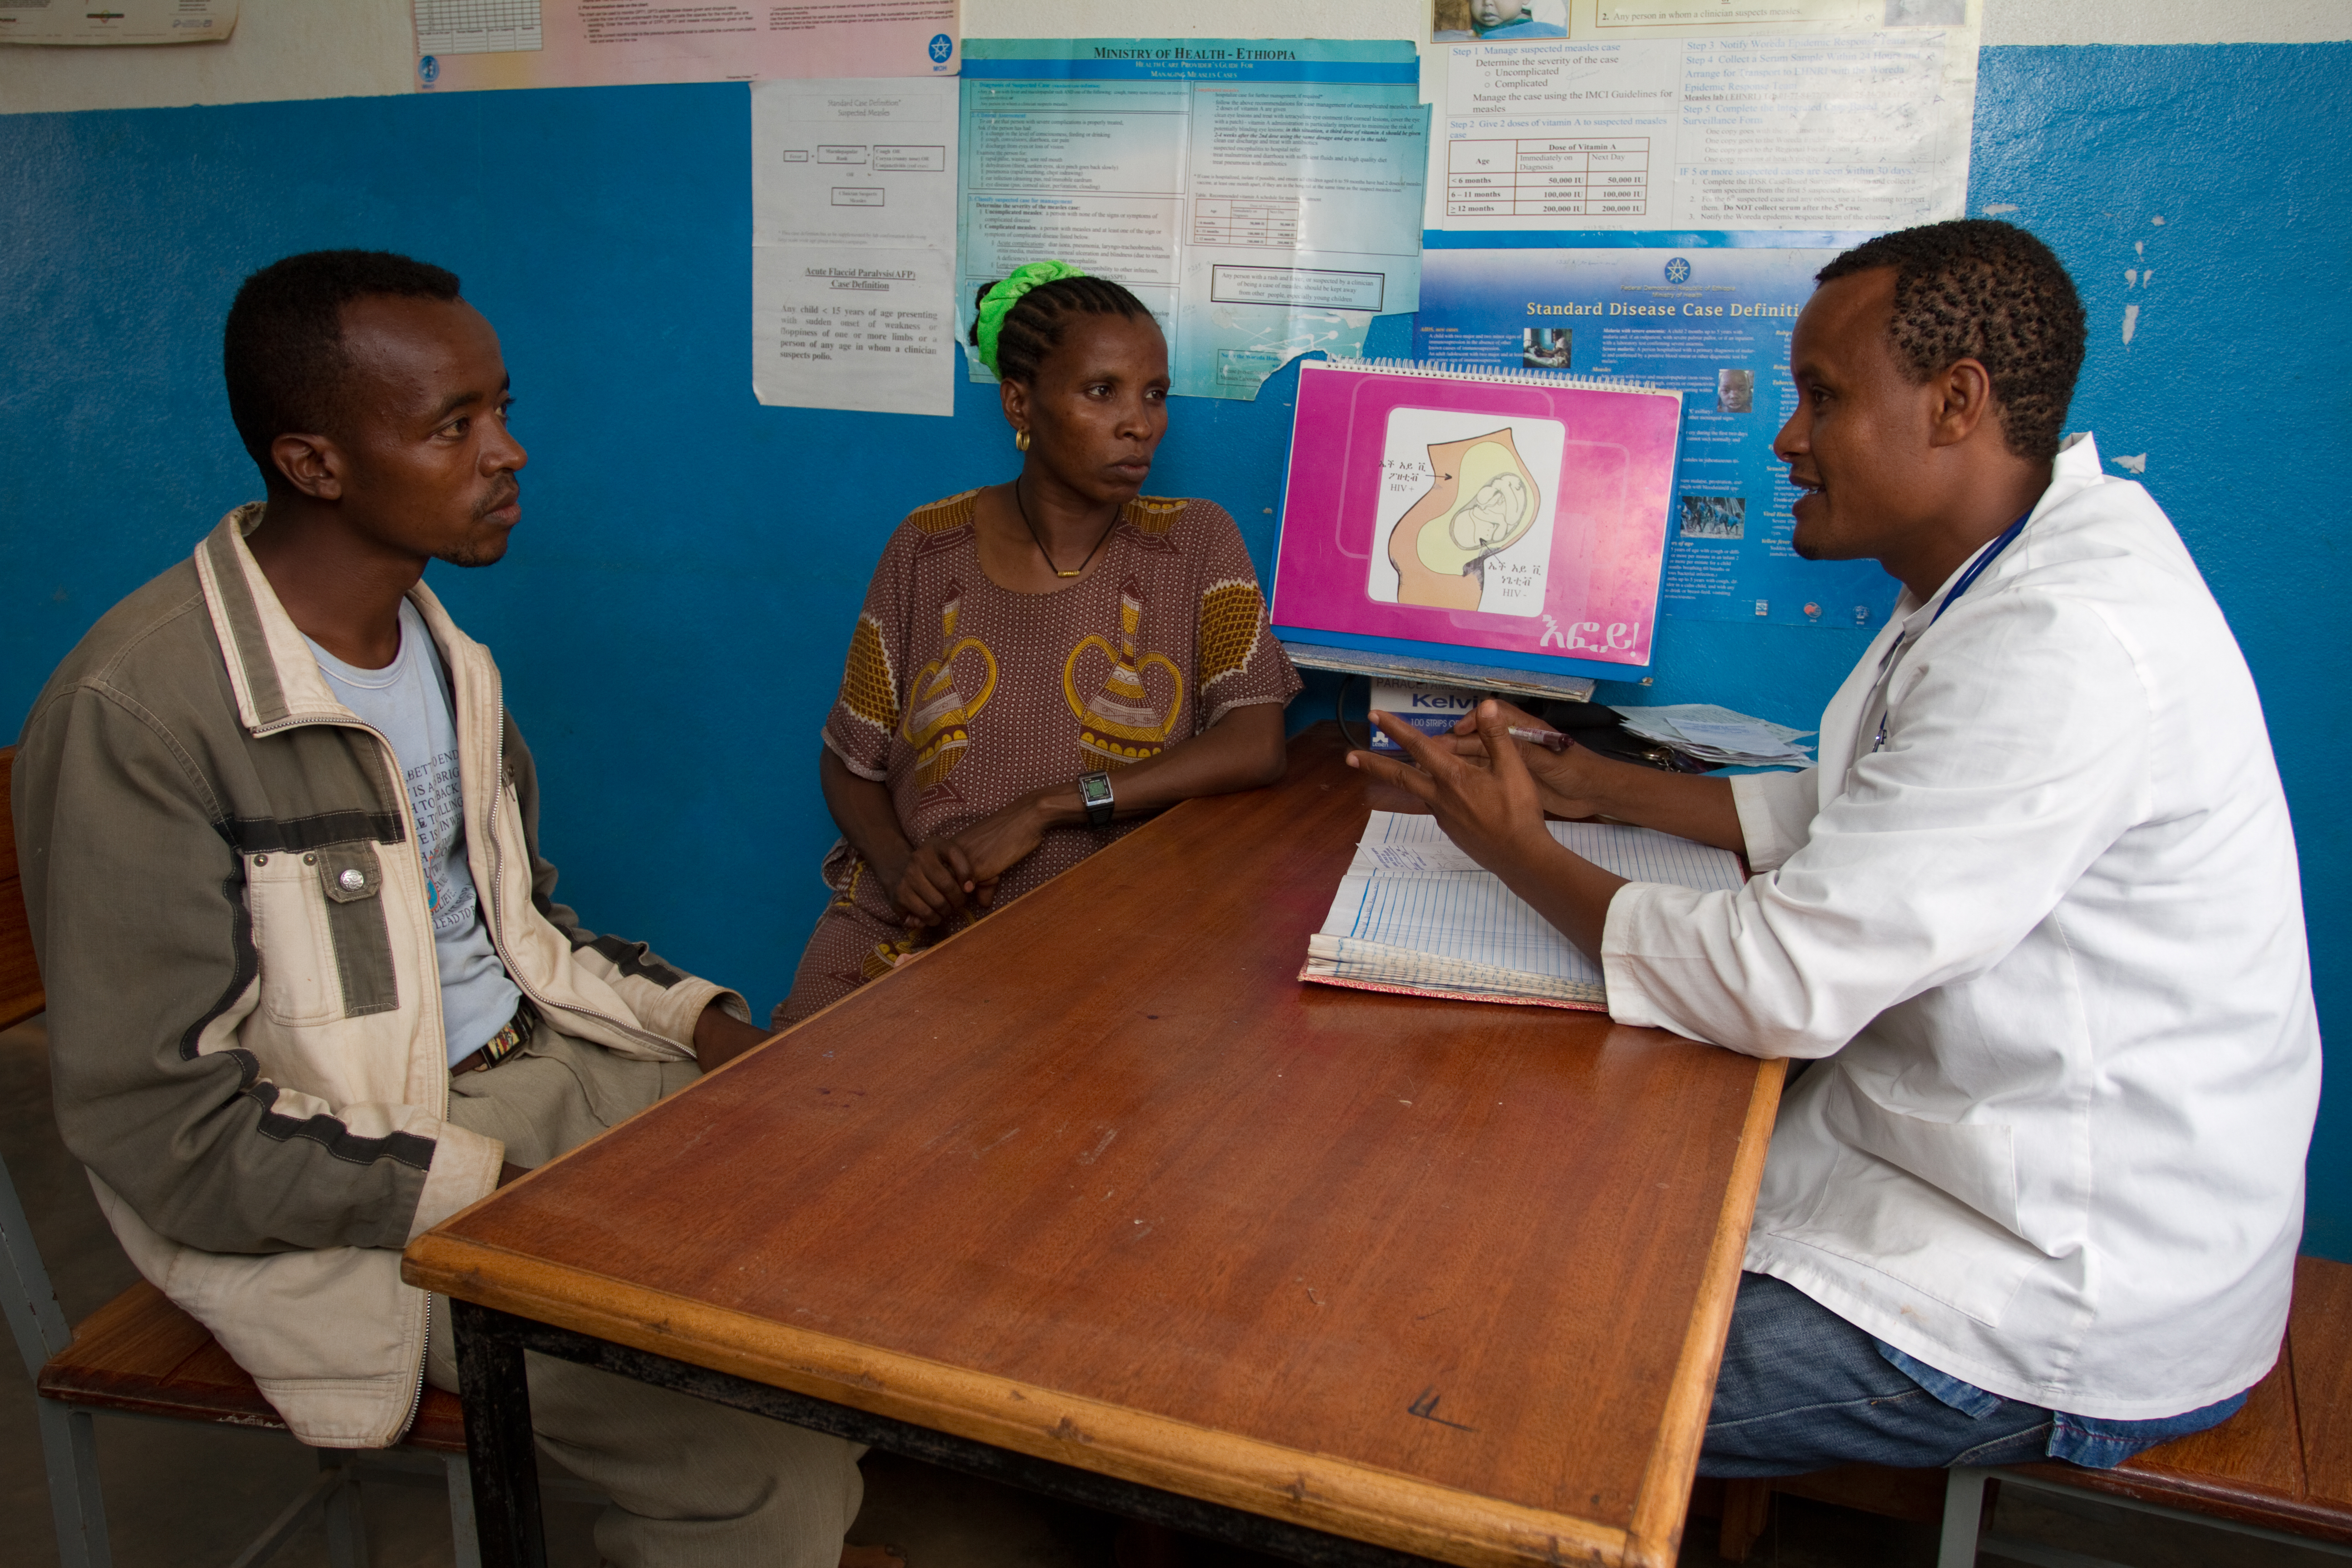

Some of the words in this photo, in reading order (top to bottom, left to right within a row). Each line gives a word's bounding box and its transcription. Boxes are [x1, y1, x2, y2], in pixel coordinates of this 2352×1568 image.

[1602, 12, 1610, 21] 2.
[1613, 13, 1630, 22] Any
[1631, 13, 1657, 22] person
[1658, 11, 1666, 19] in
[1668, 10, 1692, 19] whom
[1700, 10, 1733, 18] clinician
[1735, 9, 1768, 18] suspects
[1769, 7, 1802, 15] measles.
[1094, 47, 1153, 59] MINISTRY
[1155, 49, 1171, 59] OF
[1175, 47, 1225, 59] HEALTH
[1236, 48, 1296, 60] ETHIOPIA
[1452, 48, 1472, 58] Step
[1475, 47, 1478, 55] 1
[1484, 46, 1519, 56] Manage
[1520, 44, 1563, 56] suspected
[1564, 43, 1599, 52] measles
[1475, 58, 1520, 67] Determine
[1522, 57, 1535, 66] the
[1537, 56, 1571, 66] severity
[1572, 55, 1583, 64] of
[1584, 55, 1598, 64] the
[1495, 67, 1559, 78] Uncomplicated
[1494, 78, 1548, 89] Complicated
[1473, 93, 1507, 103] Manage
[1508, 92, 1522, 101] the
[1544, 91, 1568, 102] using
[1569, 91, 1583, 99] the
[1585, 90, 1609, 99] IMCI
[1611, 90, 1657, 98] Guidelines
[1660, 88, 1673, 98] for
[1472, 104, 1506, 113] measles
[1450, 121, 1468, 130] Step
[1479, 120, 1498, 128] Give
[1499, 119, 1505, 127] 2
[1507, 119, 1529, 127] doses
[1530, 119, 1541, 127] of
[1593, 117, 1633, 127] suspected
[1635, 117, 1667, 125] measles
[1519, 154, 1563, 163] Immediately
[1610, 153, 1625, 162] Day
[1519, 163, 1553, 172] Diagnosis
[805, 267, 827, 276] Acute
[828, 267, 856, 277] Flaccid
[830, 279, 851, 288] Case
[851, 280, 890, 289] Definition
[781, 304, 796, 314] Any
[800, 304, 819, 314] child
[832, 306, 841, 315] 15
[844, 309, 865, 317] years
[868, 308, 877, 316] of
[897, 310, 938, 321] presenting
[1526, 301, 1602, 315] Standard
[1609, 301, 1676, 316] Disease
[1682, 303, 1723, 316] Case
[1730, 303, 1804, 317] Definiti
[781, 316, 798, 324] with
[805, 317, 832, 326] sudden
[867, 319, 877, 328] of
[884, 321, 921, 330] weakness
[821, 329, 830, 338] of
[892, 333, 913, 342] limbs
[809, 340, 818, 348] of
[820, 342, 834, 351] any
[838, 343, 852, 352] age
[856, 342, 864, 351] in
[867, 343, 892, 353] whom
[904, 345, 937, 355] clinician
[780, 352, 811, 360] suspects
[812, 351, 832, 362] polio.
[1391, 483, 1407, 492] HIV
[1503, 588, 1521, 597] HIV
[1412, 693, 1480, 709] Kelvi
[1426, 719, 1447, 727] STRIPS
[413, 784, 426, 797] IS
[433, 913, 460, 930] LEAD
